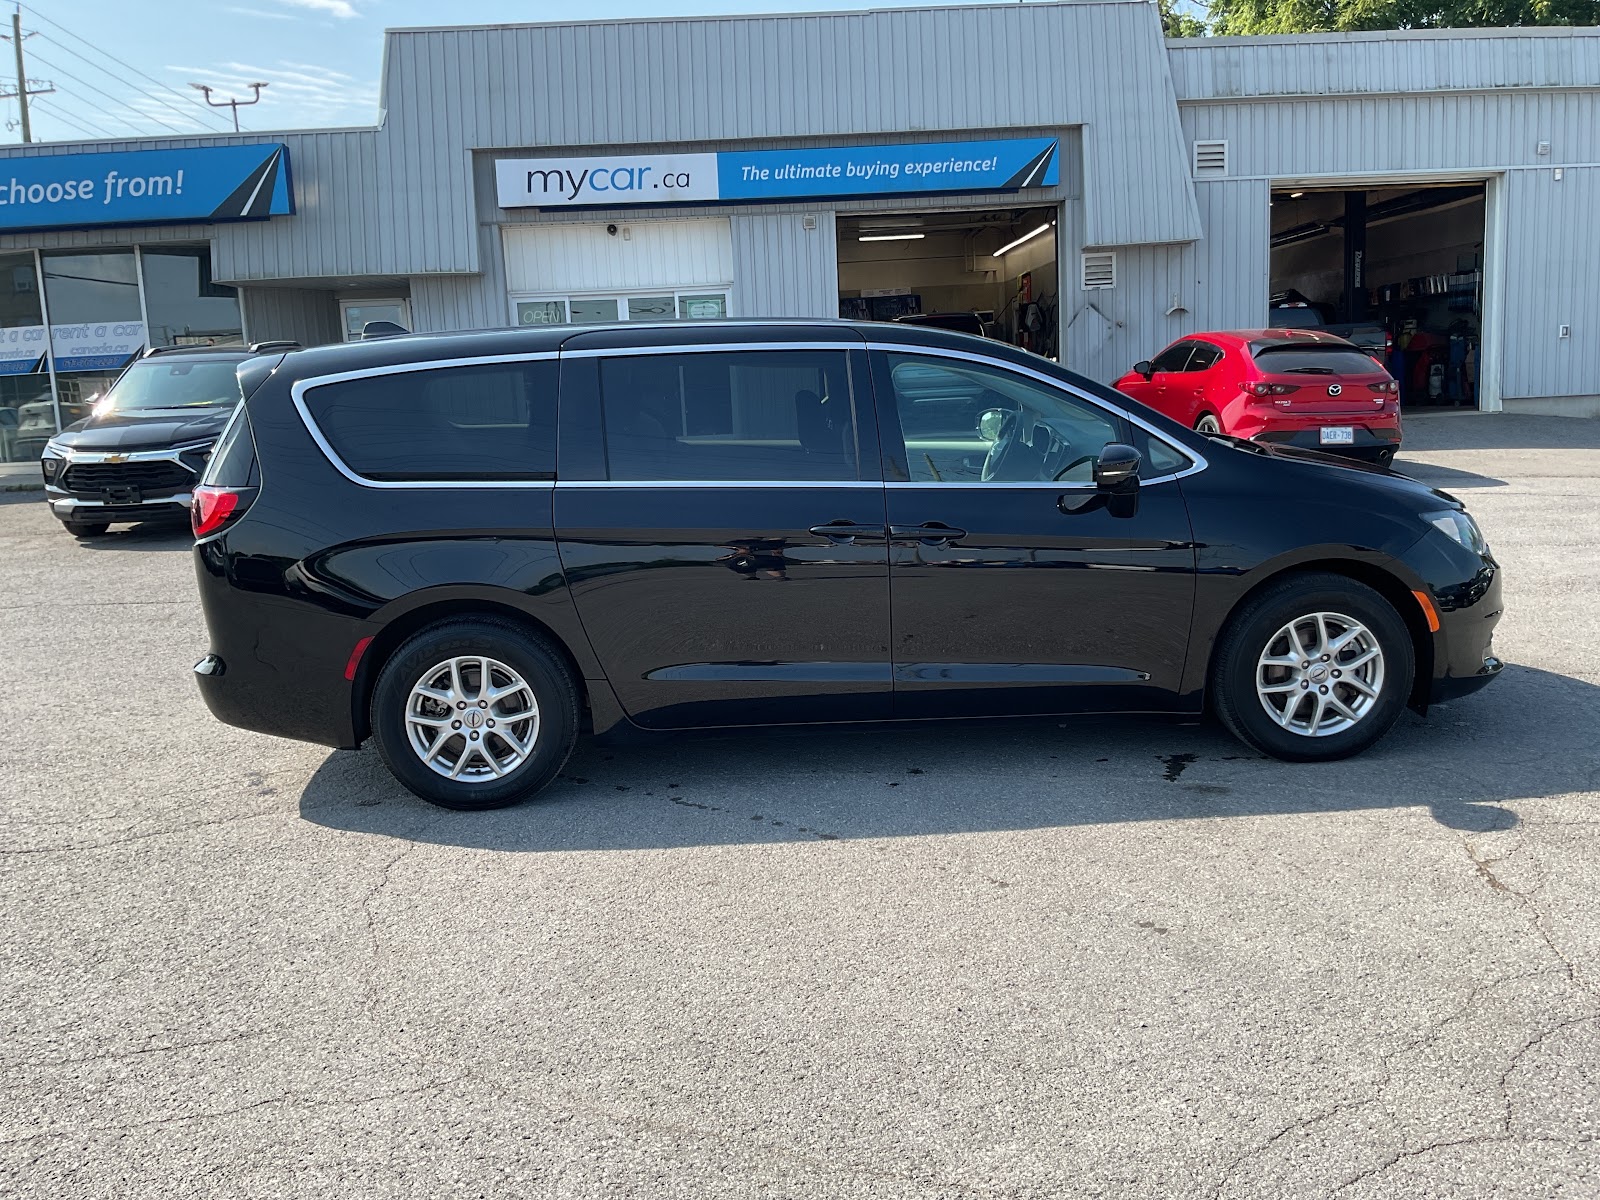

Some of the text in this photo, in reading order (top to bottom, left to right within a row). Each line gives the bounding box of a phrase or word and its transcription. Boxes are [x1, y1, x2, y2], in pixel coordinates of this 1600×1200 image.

[741, 156, 998, 181] The ultimate buying experience!
[103, 169, 184, 205] from!
[527, 166, 690, 201] mycar.ca
[523, 310, 561, 324] OPEN
[23, 328, 46, 342] car
[52, 323, 143, 340] rent a car
[70, 342, 129, 356] canada.ca
